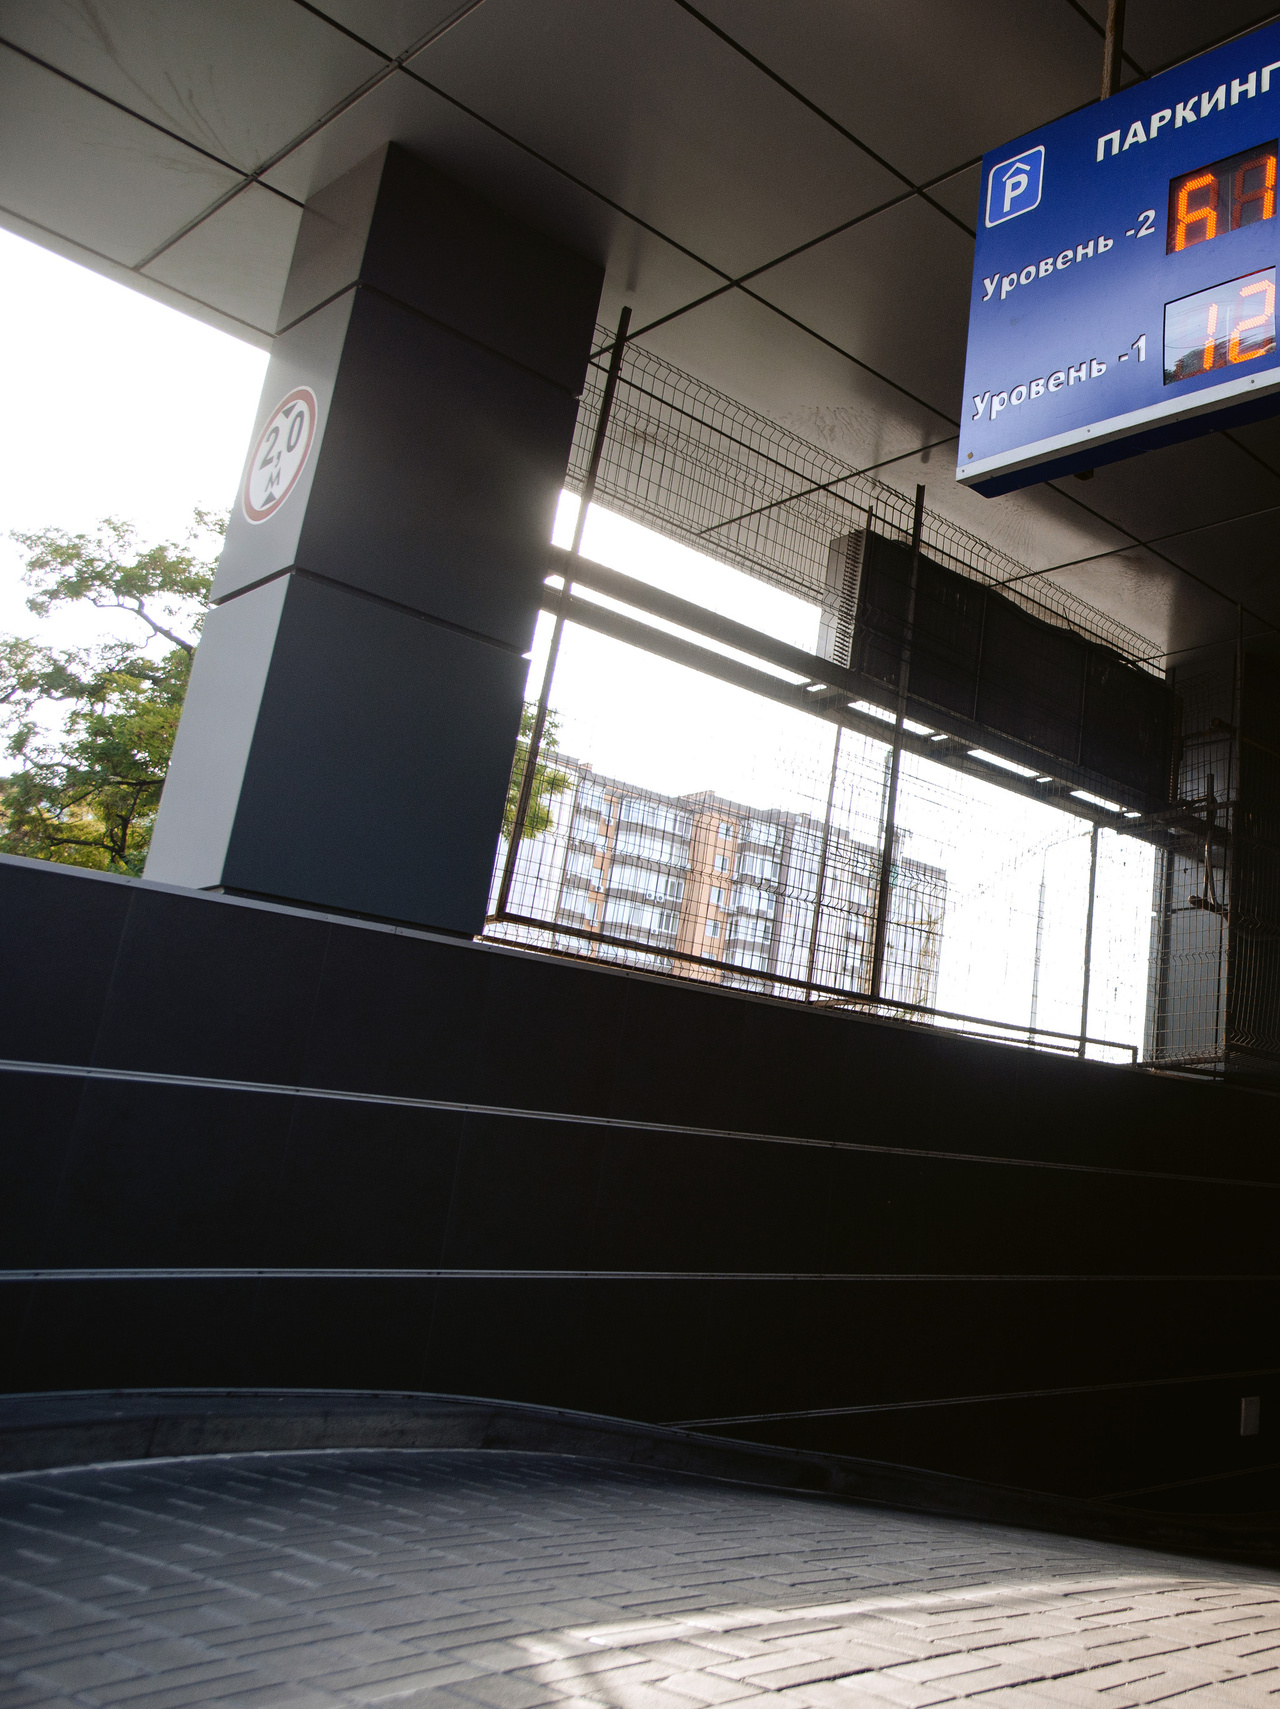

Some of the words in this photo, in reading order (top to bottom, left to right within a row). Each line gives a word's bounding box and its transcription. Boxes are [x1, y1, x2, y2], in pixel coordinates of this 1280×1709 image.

[982, 235, 1114, 302] Уровень
[1125, 209, 1156, 238] -2
[1203, 279, 1276, 371] 12
[972, 358, 1108, 421] Уровень
[1118, 334, 1146, 363] -1
